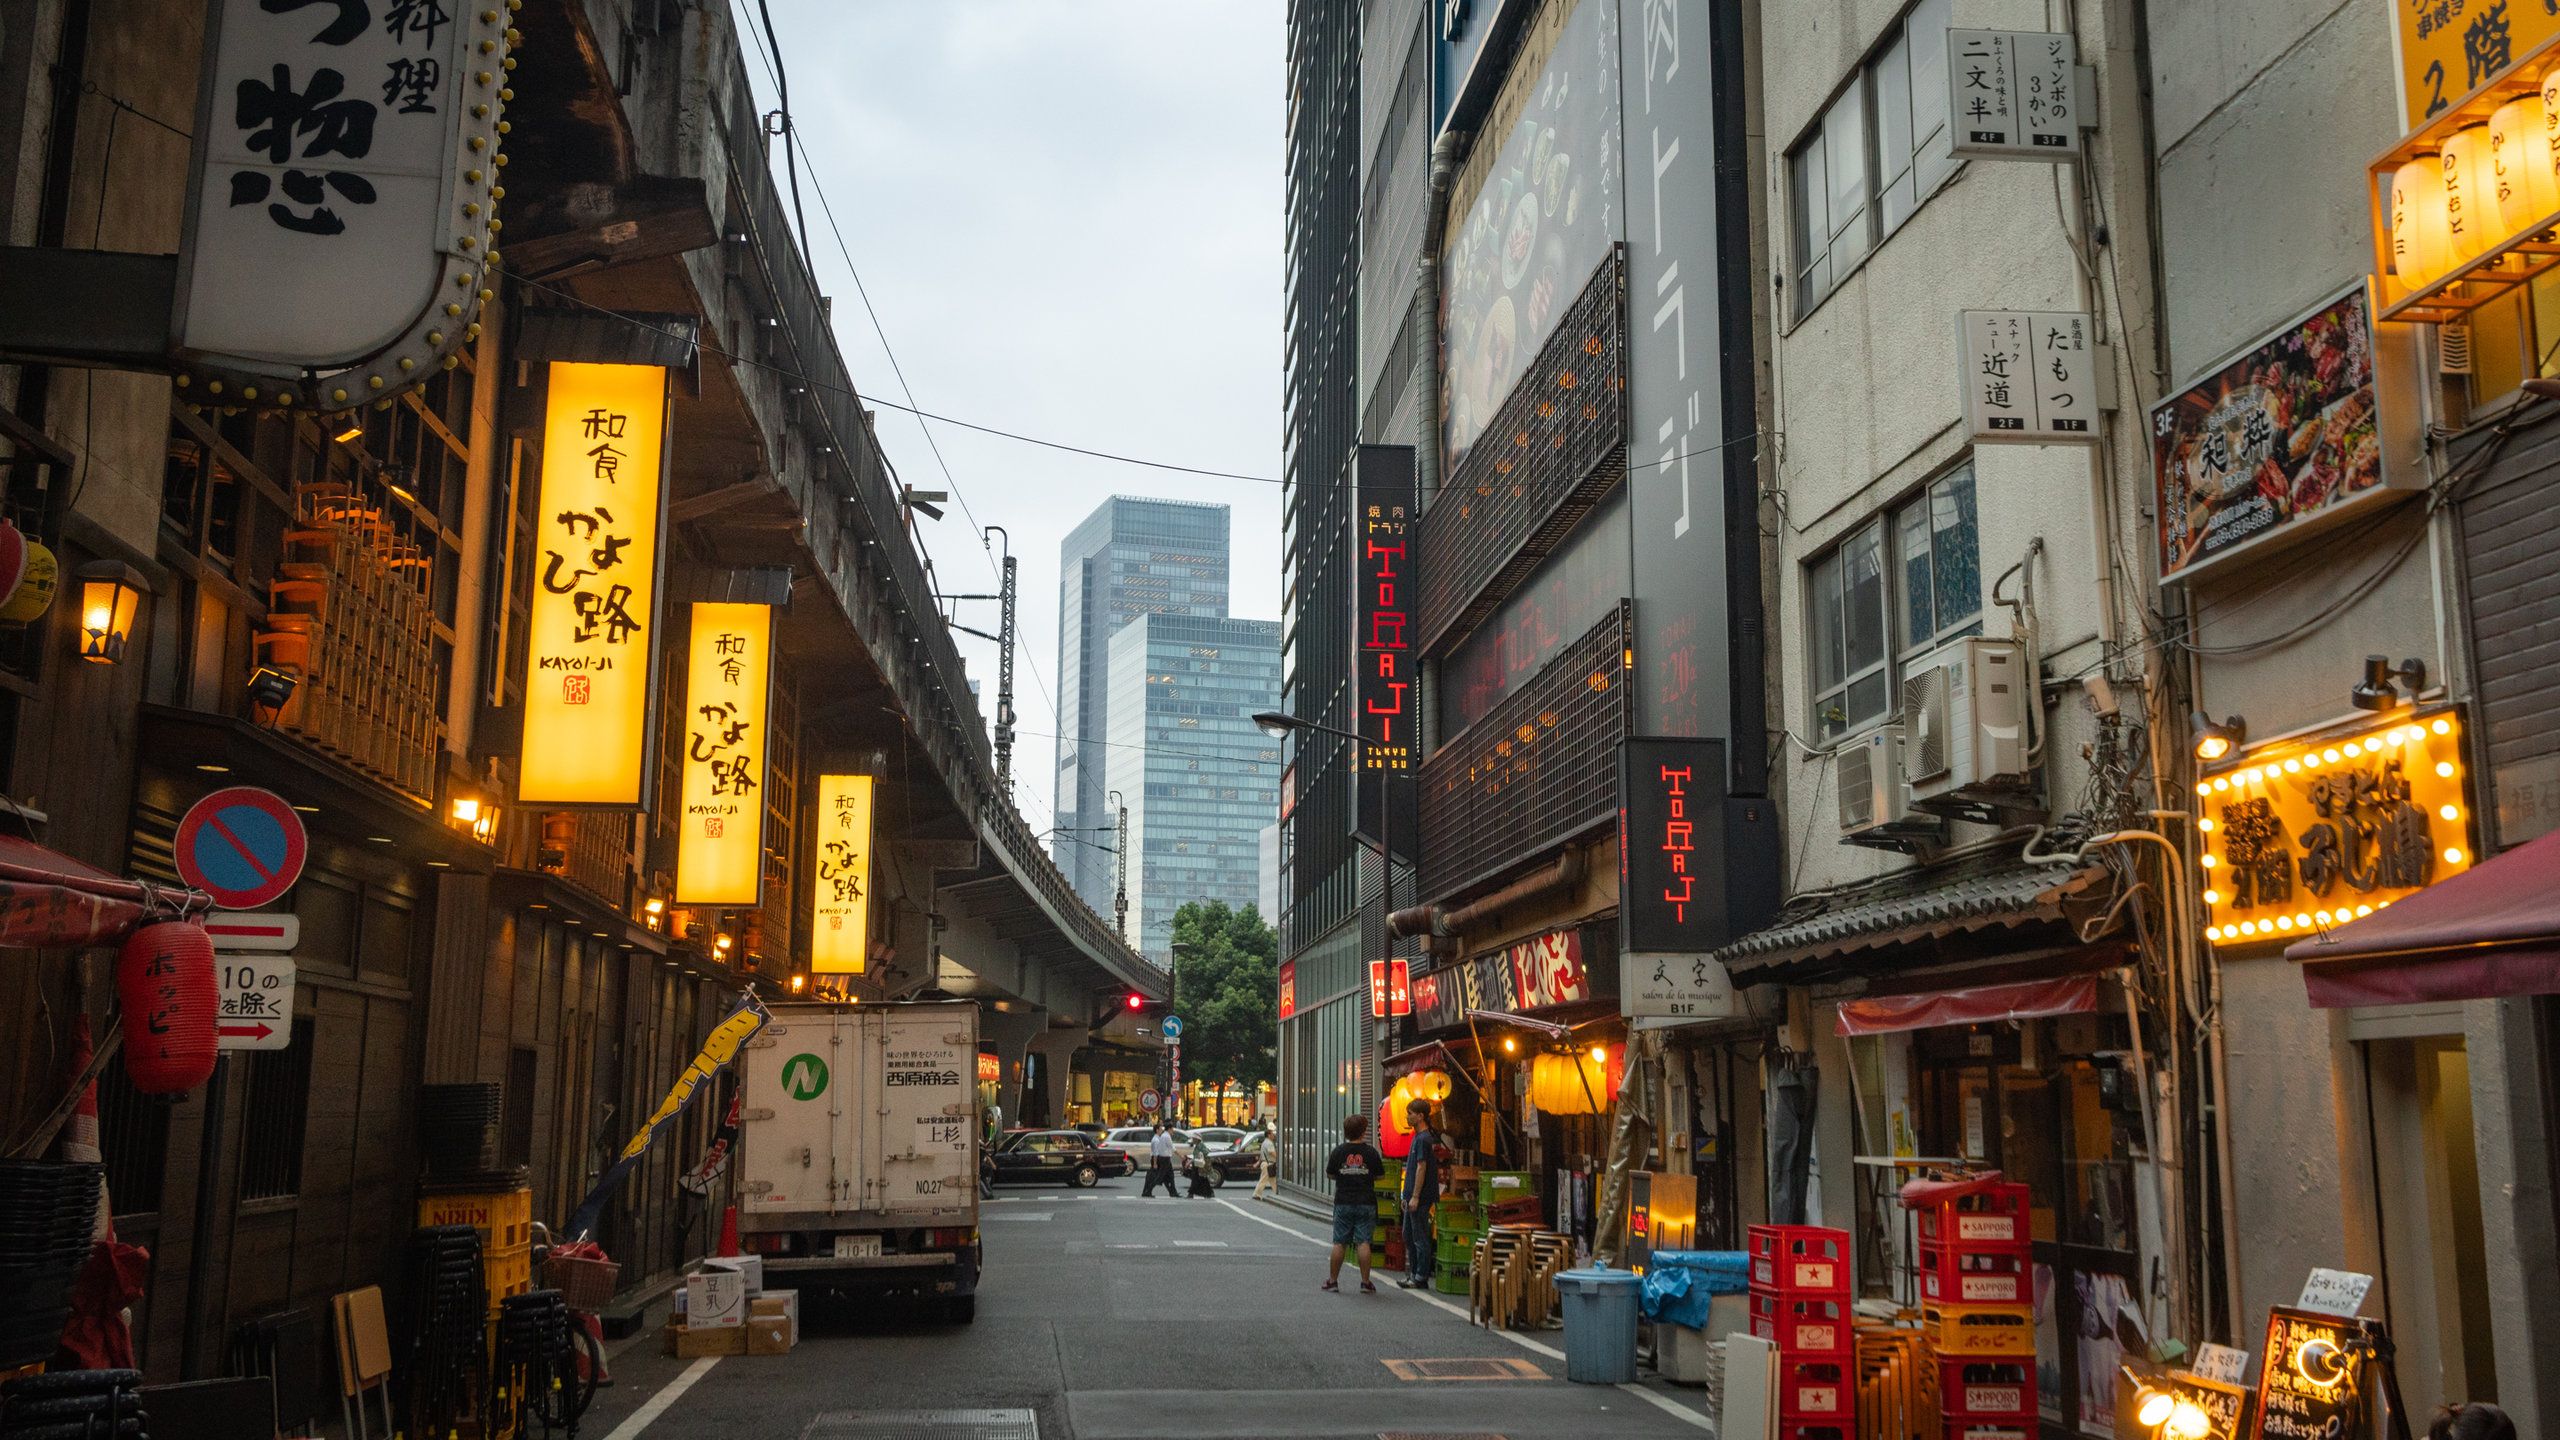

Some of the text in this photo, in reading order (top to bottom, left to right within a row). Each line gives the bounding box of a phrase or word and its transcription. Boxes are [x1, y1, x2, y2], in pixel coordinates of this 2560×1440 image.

[1961, 39, 1993, 125] 二文半
[1993, 36, 2008, 117] おふくろの味と唄
[2047, 39, 2068, 120] ジャンボの
[2028, 75, 2048, 129] 3かい
[1979, 132, 1996, 143] 4F
[2043, 136, 2059, 145] 3F
[2491, 132, 2511, 203] かしら
[2007, 318, 2020, 364] スナック
[2071, 318, 2085, 352] 居酒屋
[2046, 326, 2075, 410] たもつ
[1981, 351, 2013, 410] 近道
[1999, 418, 2015, 429] 2F
[2062, 420, 2079, 431] 1F
[2156, 407, 2174, 437] 3F
[582, 408, 628, 484] 和食
[1368, 505, 1404, 518] 焼肉
[1368, 520, 1407, 535] トラジ
[543, 507, 642, 645] かよひ路
[1366, 540, 1408, 741] TORAJI
[540, 655, 613, 671] KAYOI-JI
[714, 633, 747, 686] 和食
[690, 701, 757, 796] かよひ路
[1368, 759, 1407, 769] EBSU
[688, 804, 739, 816] KAYOI-JI
[834, 794, 856, 830] 和食
[1661, 765, 1696, 923] TORAJI
[819, 839, 864, 903] かよひ路
[818, 907, 853, 916] KAYOI-JI
[220, 992, 281, 1015] を除く
[1641, 990, 1722, 1004] salon de la musique
[1670, 1004, 1695, 1014] B1F
[887, 1070, 960, 1087] 西原商会
[916, 1117, 965, 1125] 私は安全運転の
[926, 1126, 960, 1143] 上杉
[916, 1181, 942, 1195] NO.27
[433, 1209, 488, 1225] KIRIN
[1972, 1222, 2013, 1233] SAPPORO
[705, 1276, 722, 1311] 豆乳
[1974, 1283, 2016, 1294] SAPPORO
[1965, 1332, 2018, 1348] ホッピー
